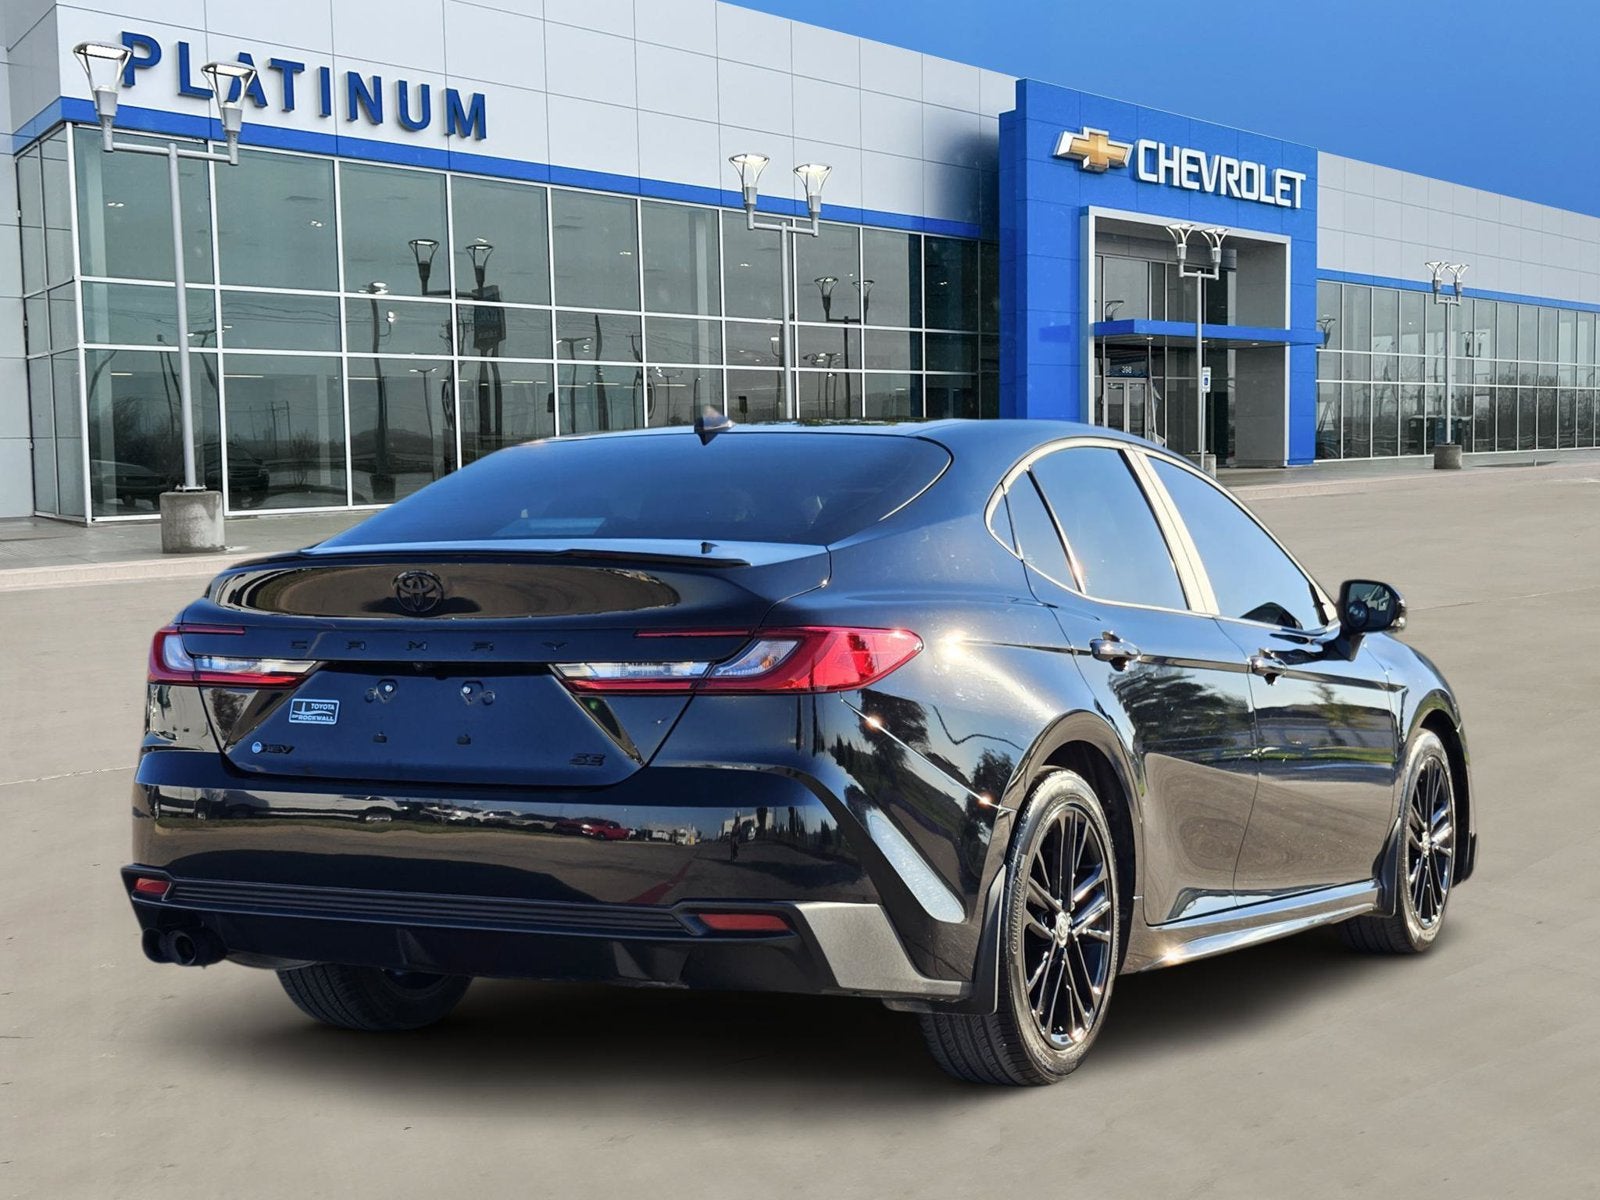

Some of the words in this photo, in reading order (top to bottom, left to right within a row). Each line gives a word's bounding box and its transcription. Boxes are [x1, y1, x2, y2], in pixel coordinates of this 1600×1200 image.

[121, 31, 487, 141] PLATINUM
[1137, 138, 1307, 209] CHEVROLET
[290, 639, 567, 652] CAMRY
[298, 714, 335, 722] ROCKWALL
